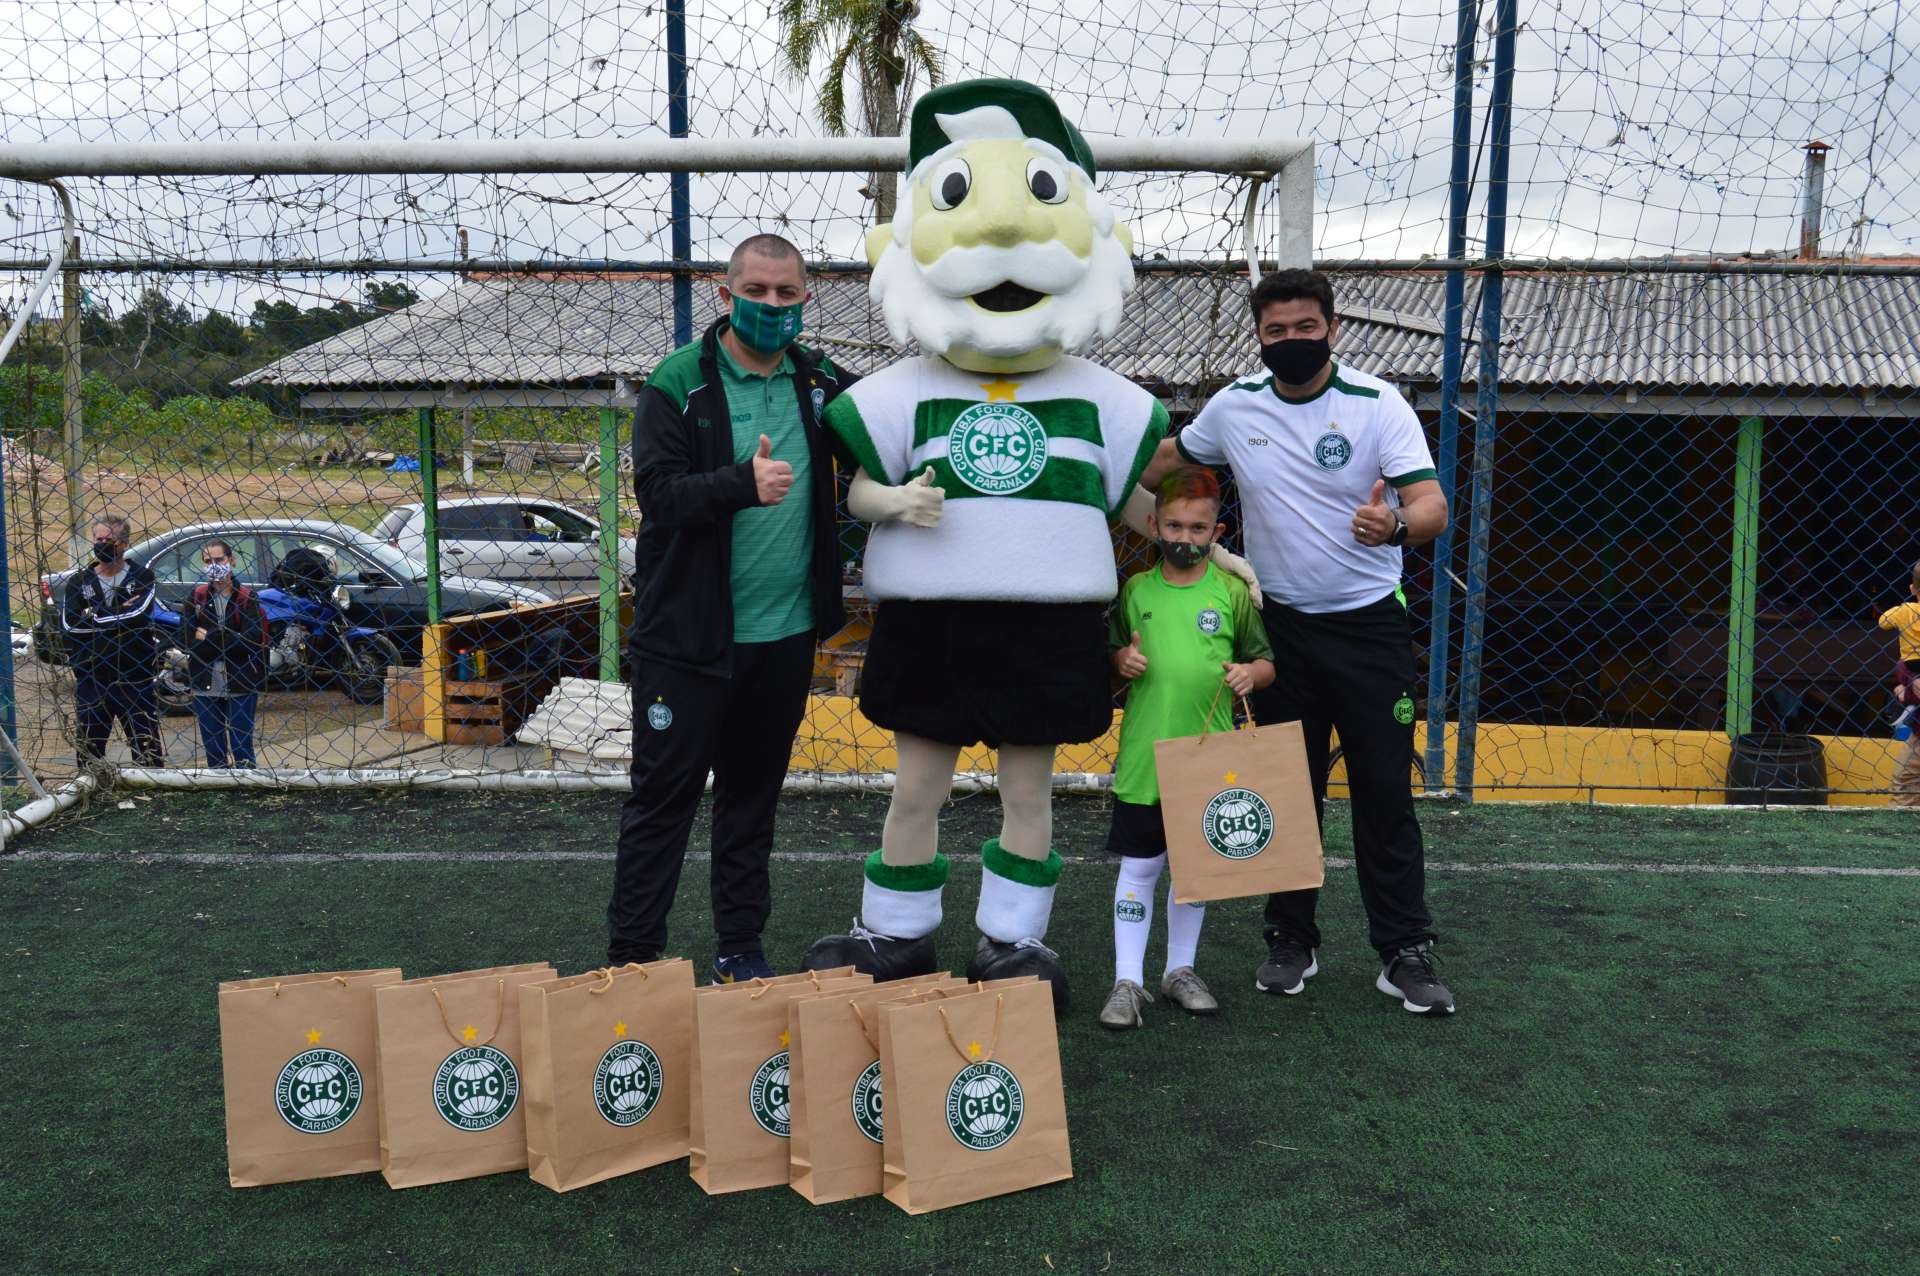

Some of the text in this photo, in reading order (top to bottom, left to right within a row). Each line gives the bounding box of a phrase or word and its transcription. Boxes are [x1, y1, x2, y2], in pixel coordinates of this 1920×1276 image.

[951, 405, 1044, 472] CORITIBA FOOT BALL CLUB
[969, 434, 1026, 457] CFC
[1248, 437, 1268, 447] 1909
[1205, 791, 1271, 840] CORITIBA FOOT BALL CLUB
[1220, 813, 1257, 834] CFC
[278, 1052, 359, 1109] CORITIBA FOOT BALL CLUB
[296, 1080, 342, 1103] CFC
[437, 1048, 516, 1107] CORITIBA FOOT BALL CLUB
[454, 1076, 499, 1100] CFC
[596, 1044, 660, 1105] CORITIBA FOOT BALL CLUB
[610, 1070, 646, 1096] CFC
[752, 1066, 773, 1112] CORITIBA
[855, 1073, 873, 1120] CORITIBA
[949, 1065, 1021, 1126] CORITIBA FOOT BALL CLUB
[965, 1092, 1006, 1119] CFC
